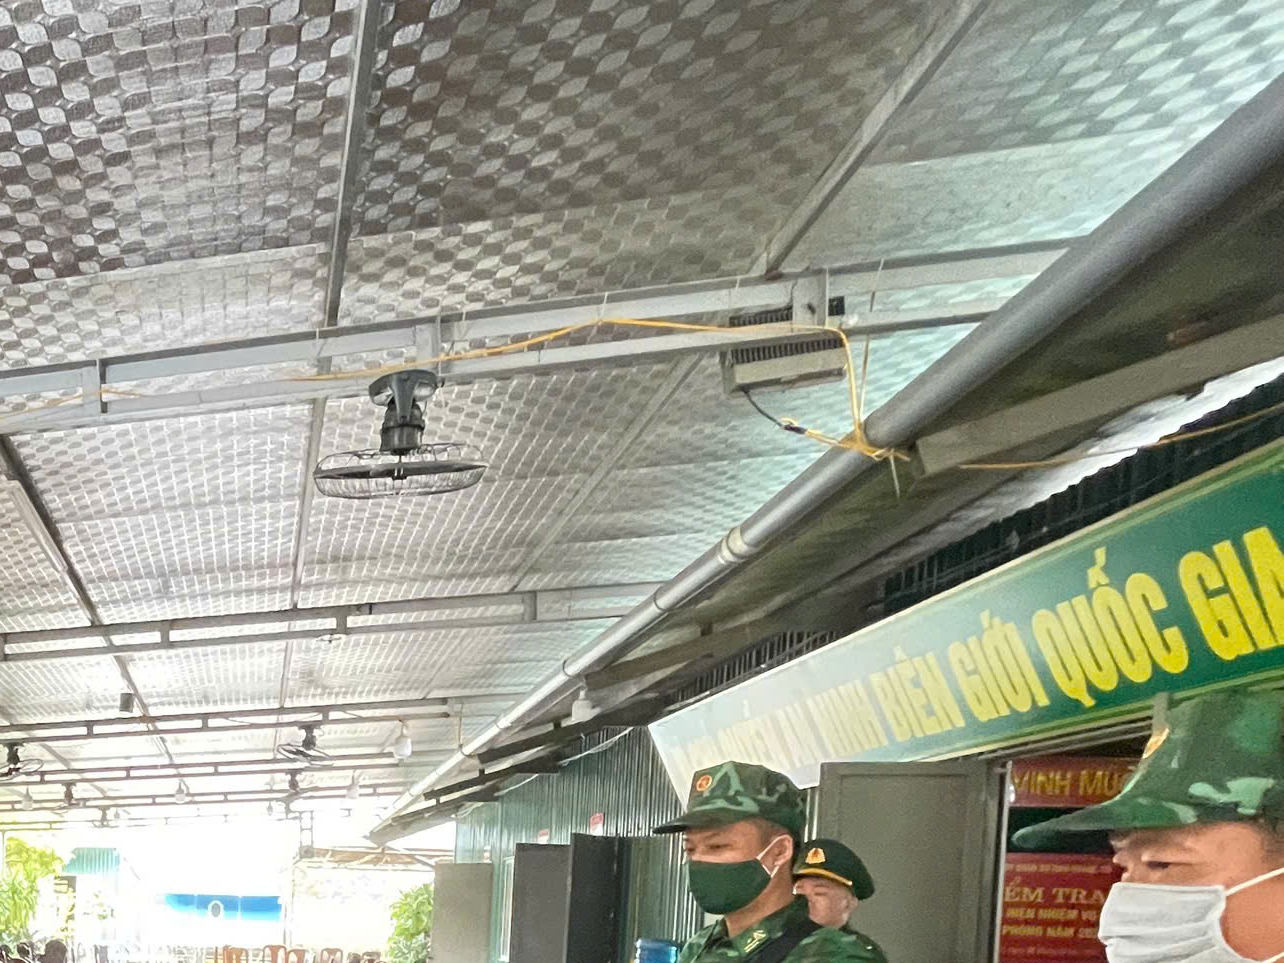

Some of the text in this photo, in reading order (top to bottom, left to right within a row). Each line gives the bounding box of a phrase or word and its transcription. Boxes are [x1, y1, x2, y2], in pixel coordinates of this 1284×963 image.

[803, 677, 890, 758] NINH
[872, 645, 966, 743] BIÊN
[948, 609, 1051, 722] GIỚI
[1031, 546, 1189, 708] QUỐC
[1179, 526, 1284, 661] GIA
